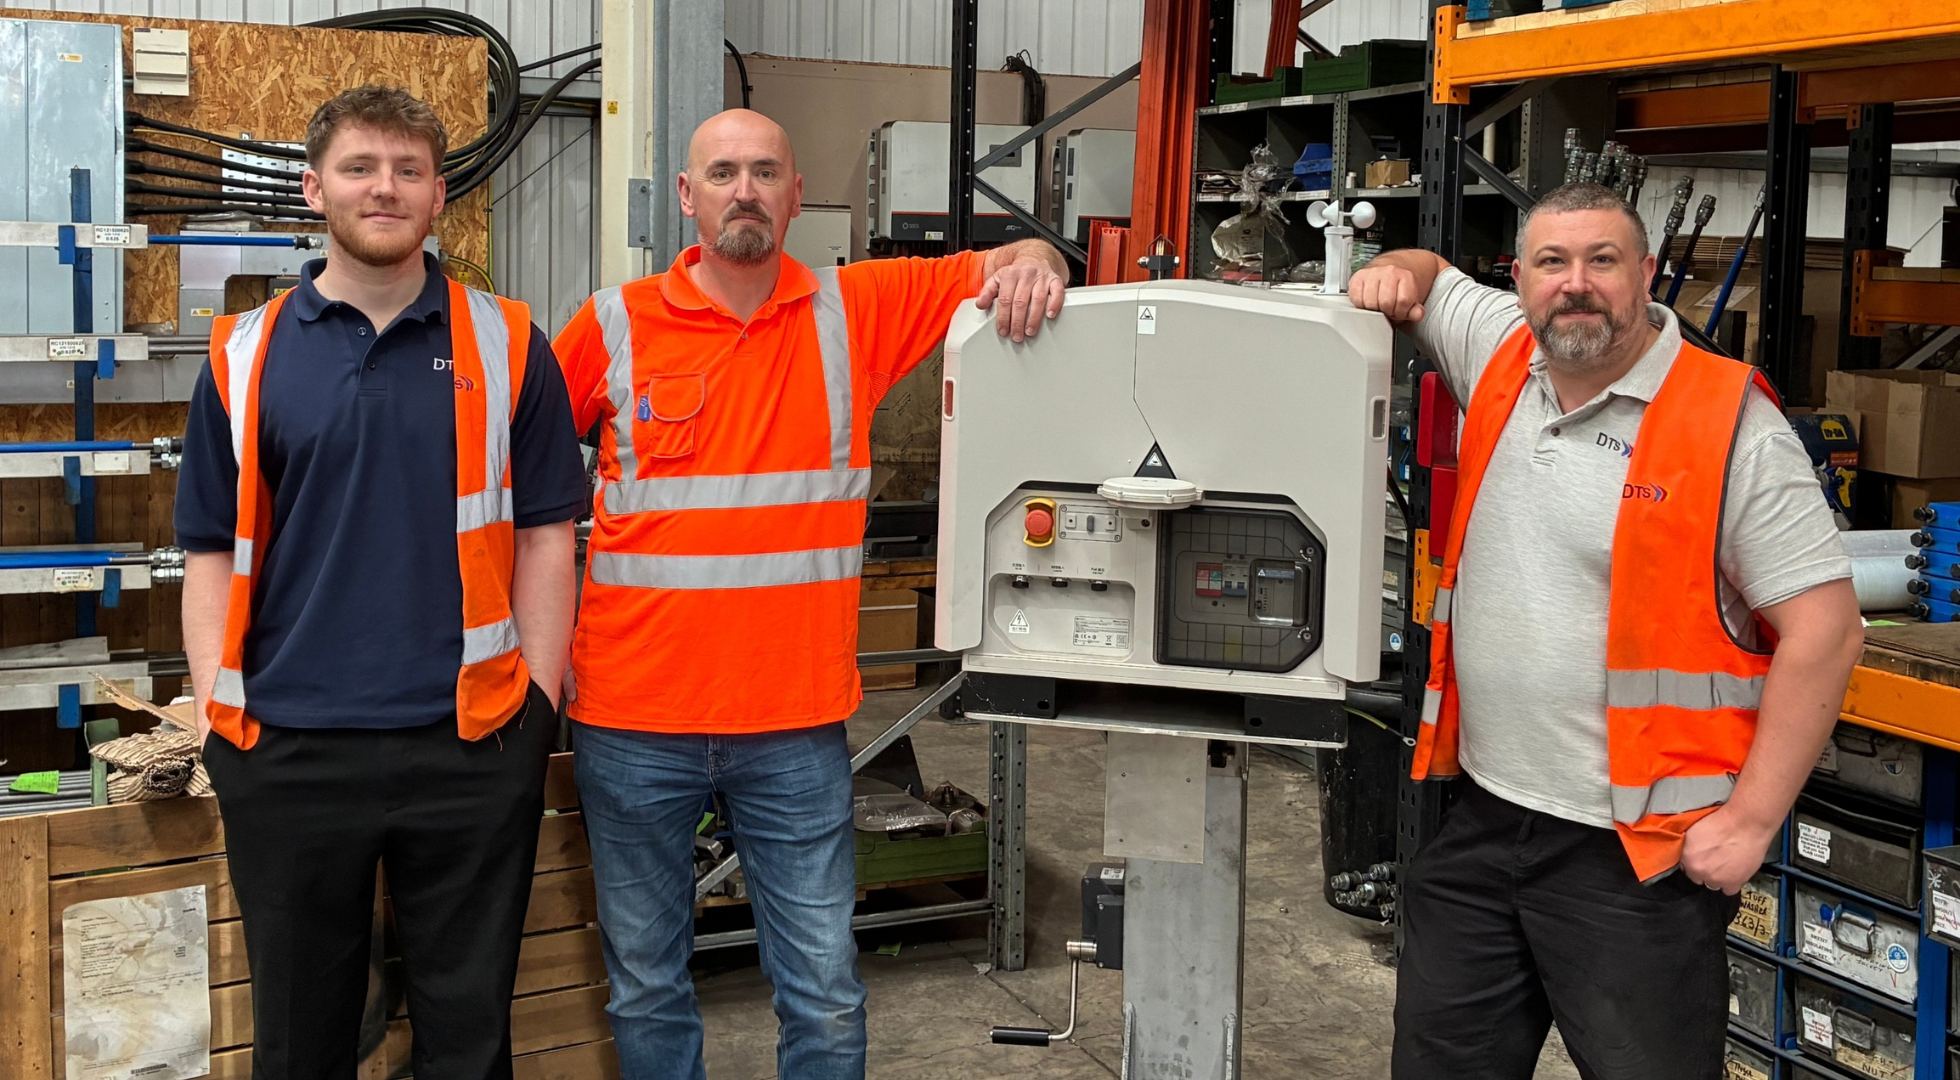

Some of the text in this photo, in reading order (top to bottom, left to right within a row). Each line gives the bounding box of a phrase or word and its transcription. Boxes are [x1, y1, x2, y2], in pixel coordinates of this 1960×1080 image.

[434, 357, 454, 370] DT
[1596, 432, 1621, 452] DTS
[1622, 484, 1651, 498] DTS
[1862, 1062, 1888, 1078] NUT
